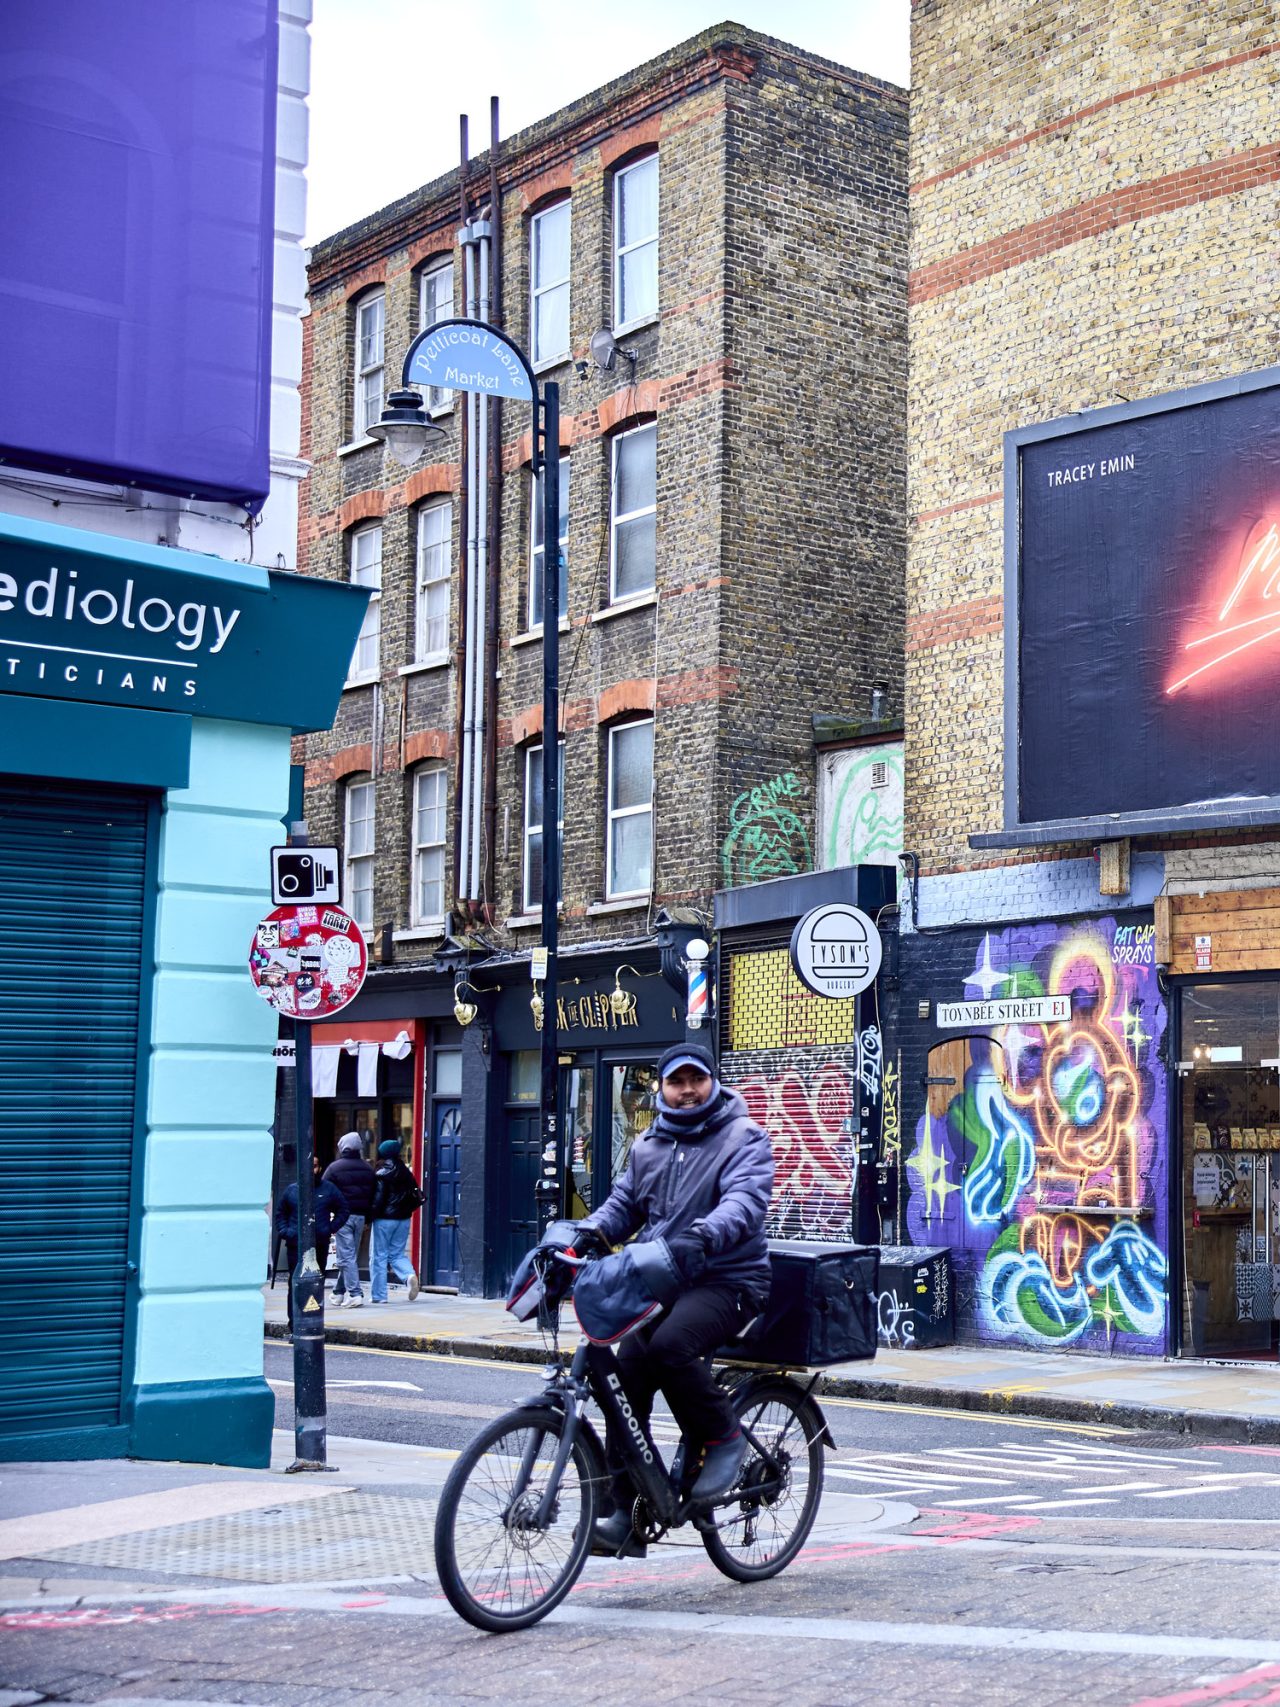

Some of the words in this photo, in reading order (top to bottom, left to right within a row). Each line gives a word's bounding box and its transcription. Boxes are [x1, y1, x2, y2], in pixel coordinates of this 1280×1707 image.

[415, 331, 489, 374] Petticoat
[491, 341, 524, 388] Lane
[444, 366, 500, 390] Market
[1047, 463, 1096, 487] TRACEY
[1100, 454, 1135, 476] EMIN
[0, 567, 241, 653] ediology
[7, 658, 197, 696] TICIANS
[1113, 926, 1135, 946] FAT
[1135, 924, 1155, 945] CAP
[810, 944, 870, 964] TYSON'S
[1112, 945, 1152, 964] SPRAYS
[942, 1005, 995, 1022] TOYNBEE
[998, 1003, 1044, 1019] STREET
[1052, 1001, 1066, 1016] E1
[615, 1390, 654, 1464] zoomo
